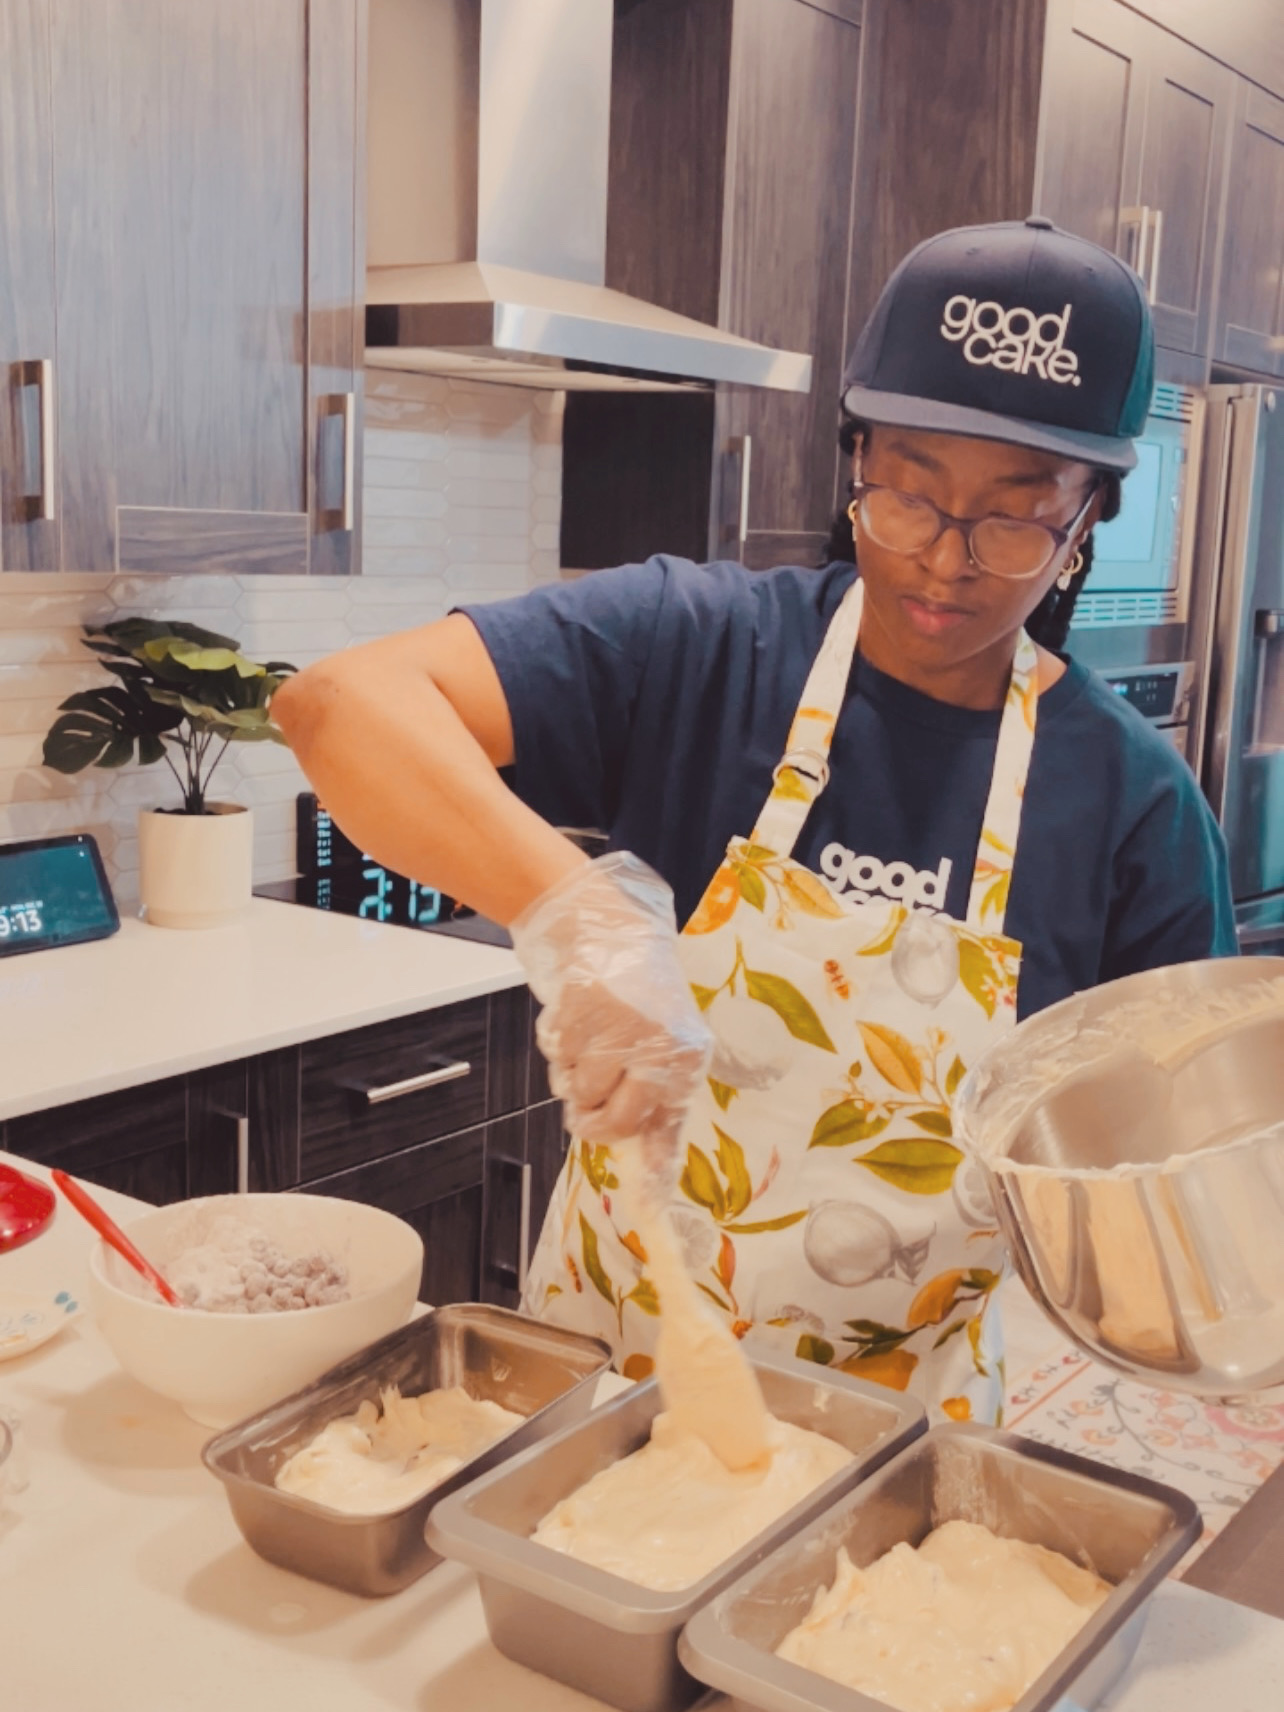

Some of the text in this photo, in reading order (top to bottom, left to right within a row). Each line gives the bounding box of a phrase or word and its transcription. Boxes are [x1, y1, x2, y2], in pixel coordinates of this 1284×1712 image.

[940, 295, 1073, 350] good
[963, 331, 1081, 387] cake.
[818, 842, 953, 909] good
[0, 909, 43, 937] 9:13
